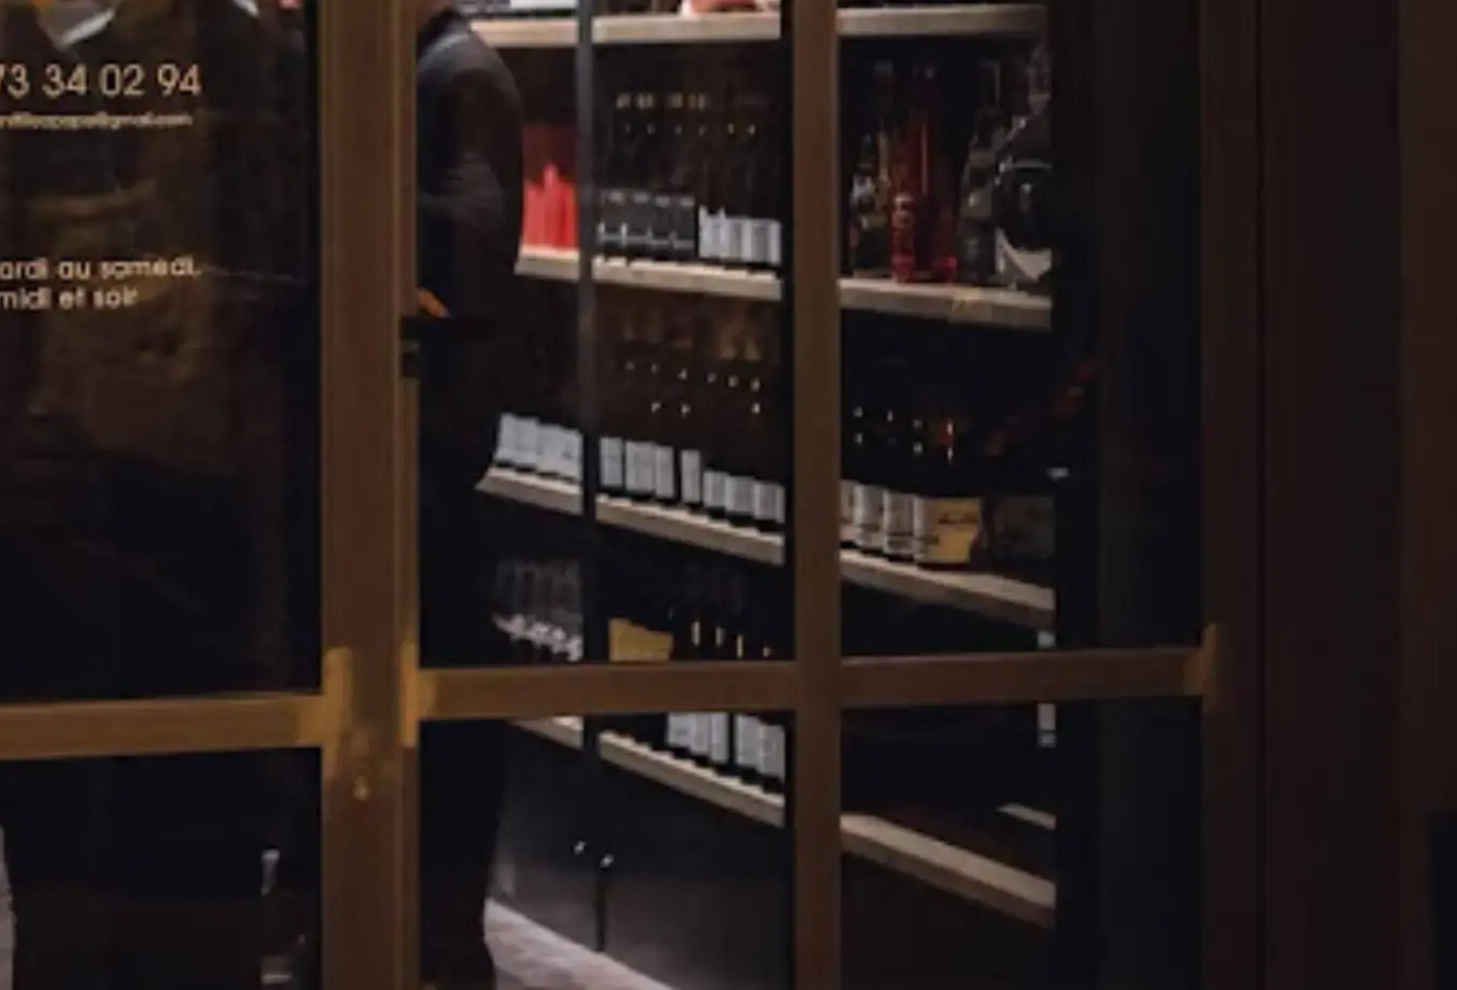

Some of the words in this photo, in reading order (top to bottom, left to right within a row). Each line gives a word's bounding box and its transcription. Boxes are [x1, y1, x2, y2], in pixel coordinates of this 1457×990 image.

[42, 63, 89, 99] 34
[98, 62, 146, 98] 02
[155, 62, 203, 97] 94
[58, 260, 92, 281] au
[58, 287, 88, 310] et
